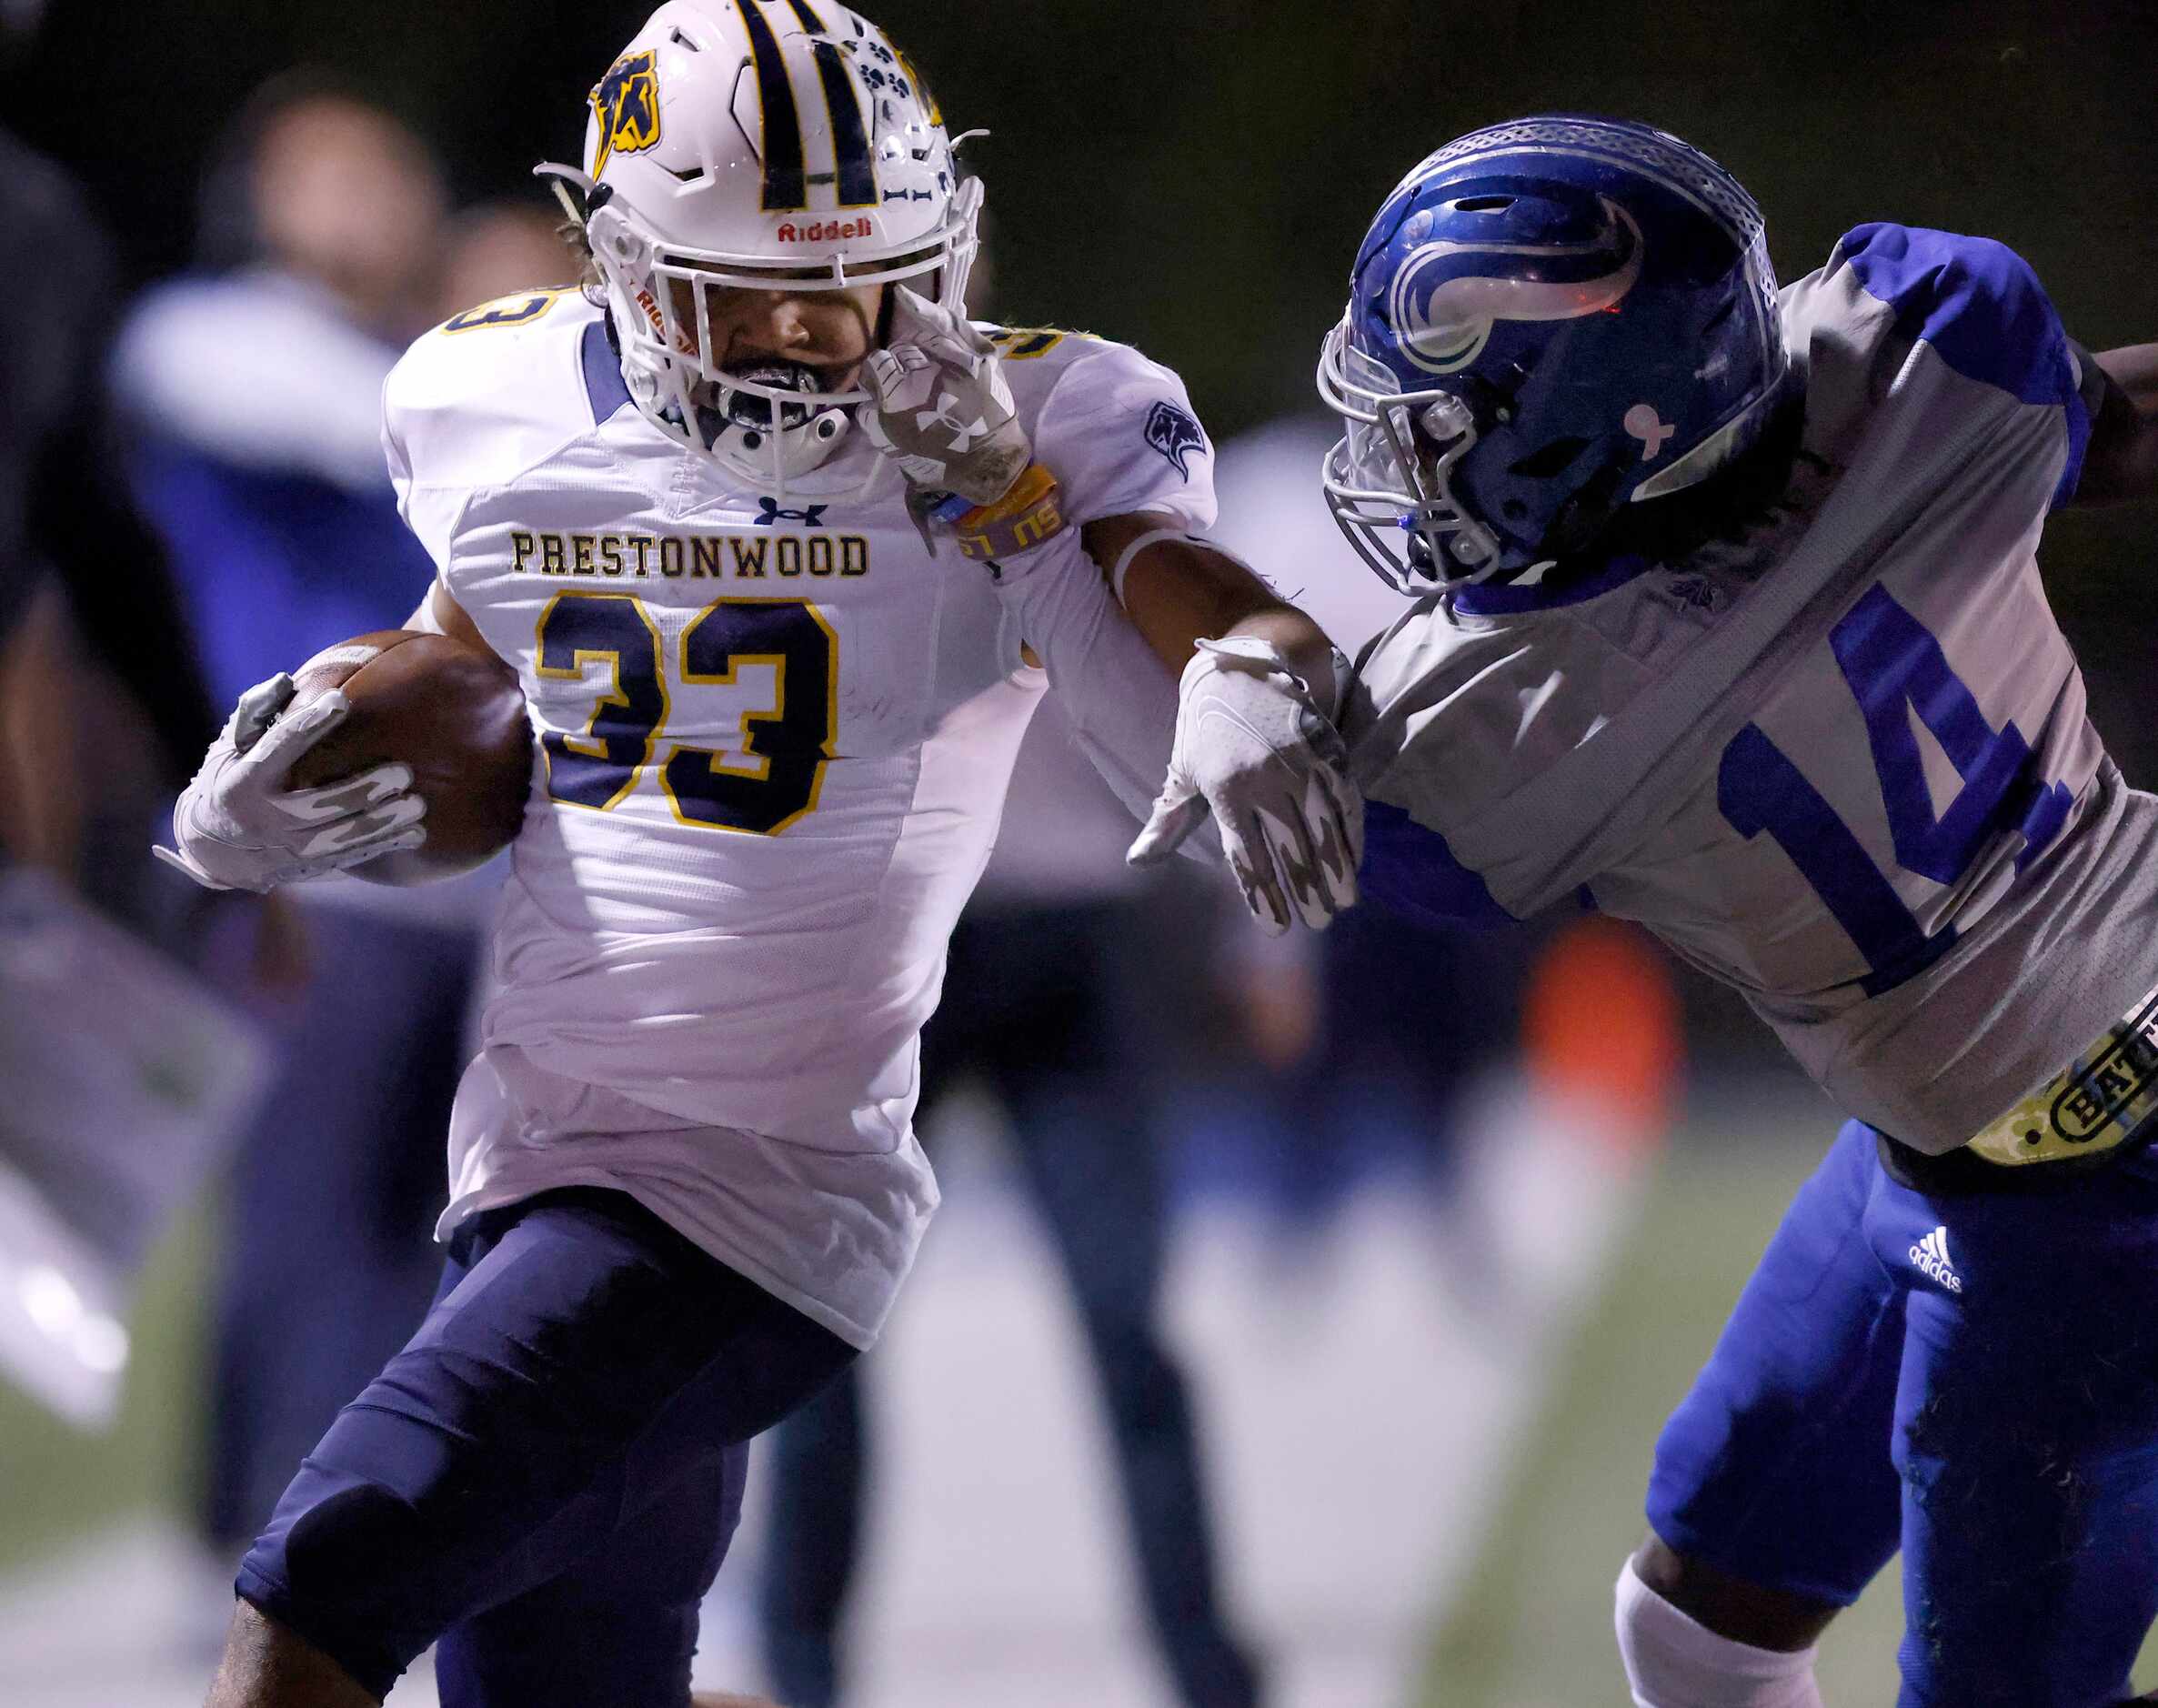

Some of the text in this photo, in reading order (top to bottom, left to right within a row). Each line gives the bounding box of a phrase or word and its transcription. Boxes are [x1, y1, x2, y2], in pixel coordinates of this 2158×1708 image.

[778, 216, 871, 242] Riddell
[510, 531, 870, 578] PRESTONWOOD
[535, 589, 838, 837] 33
[1717, 580, 2073, 999] 14
[1909, 1245, 1962, 1293] adidas
